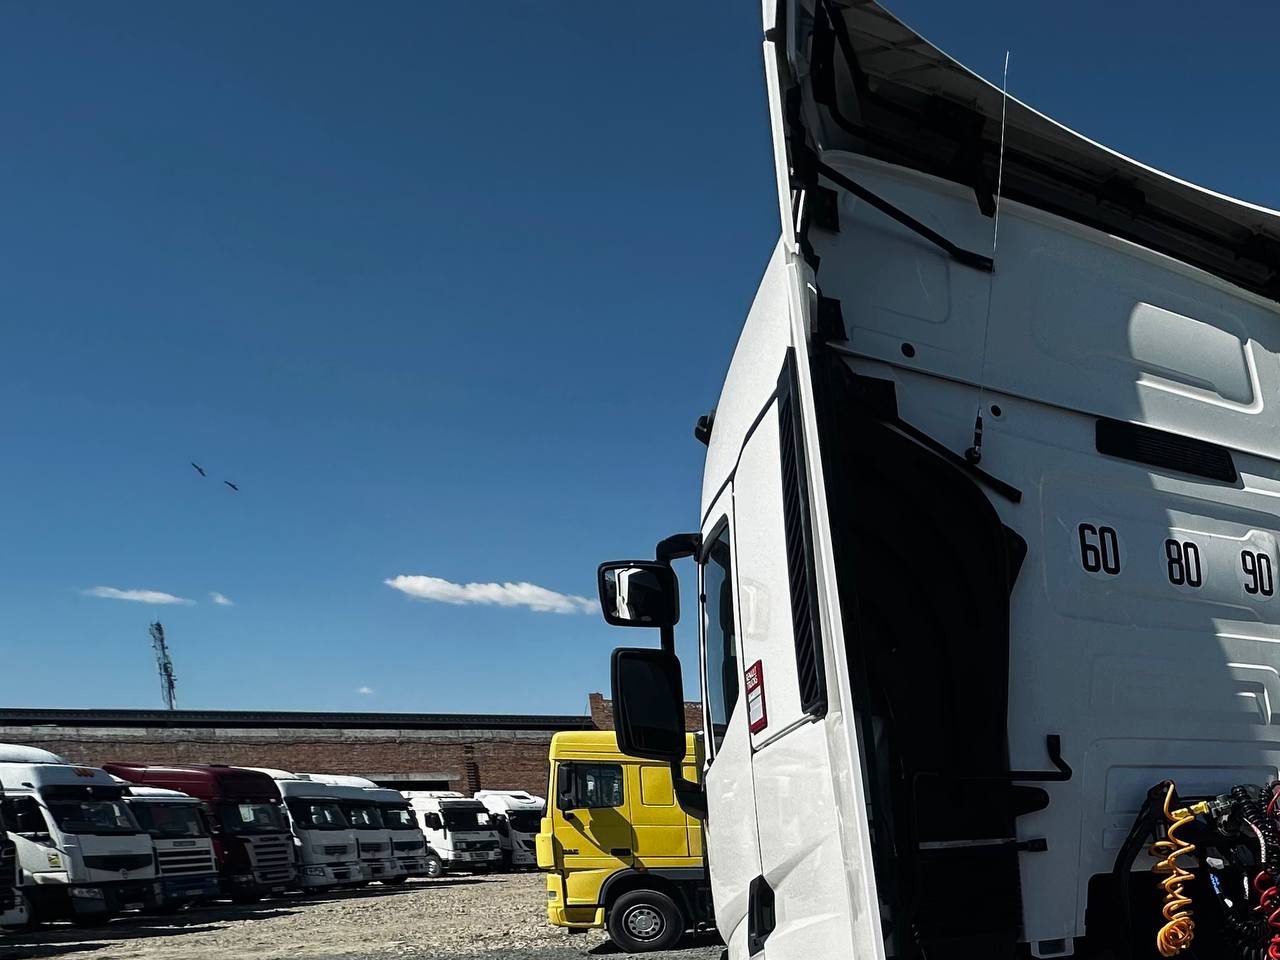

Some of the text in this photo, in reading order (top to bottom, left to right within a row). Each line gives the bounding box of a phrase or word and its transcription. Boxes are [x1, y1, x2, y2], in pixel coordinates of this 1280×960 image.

[1078, 523, 1121, 575] 60
[1164, 538, 1202, 588] 80
[1240, 550, 1274, 597] 90
